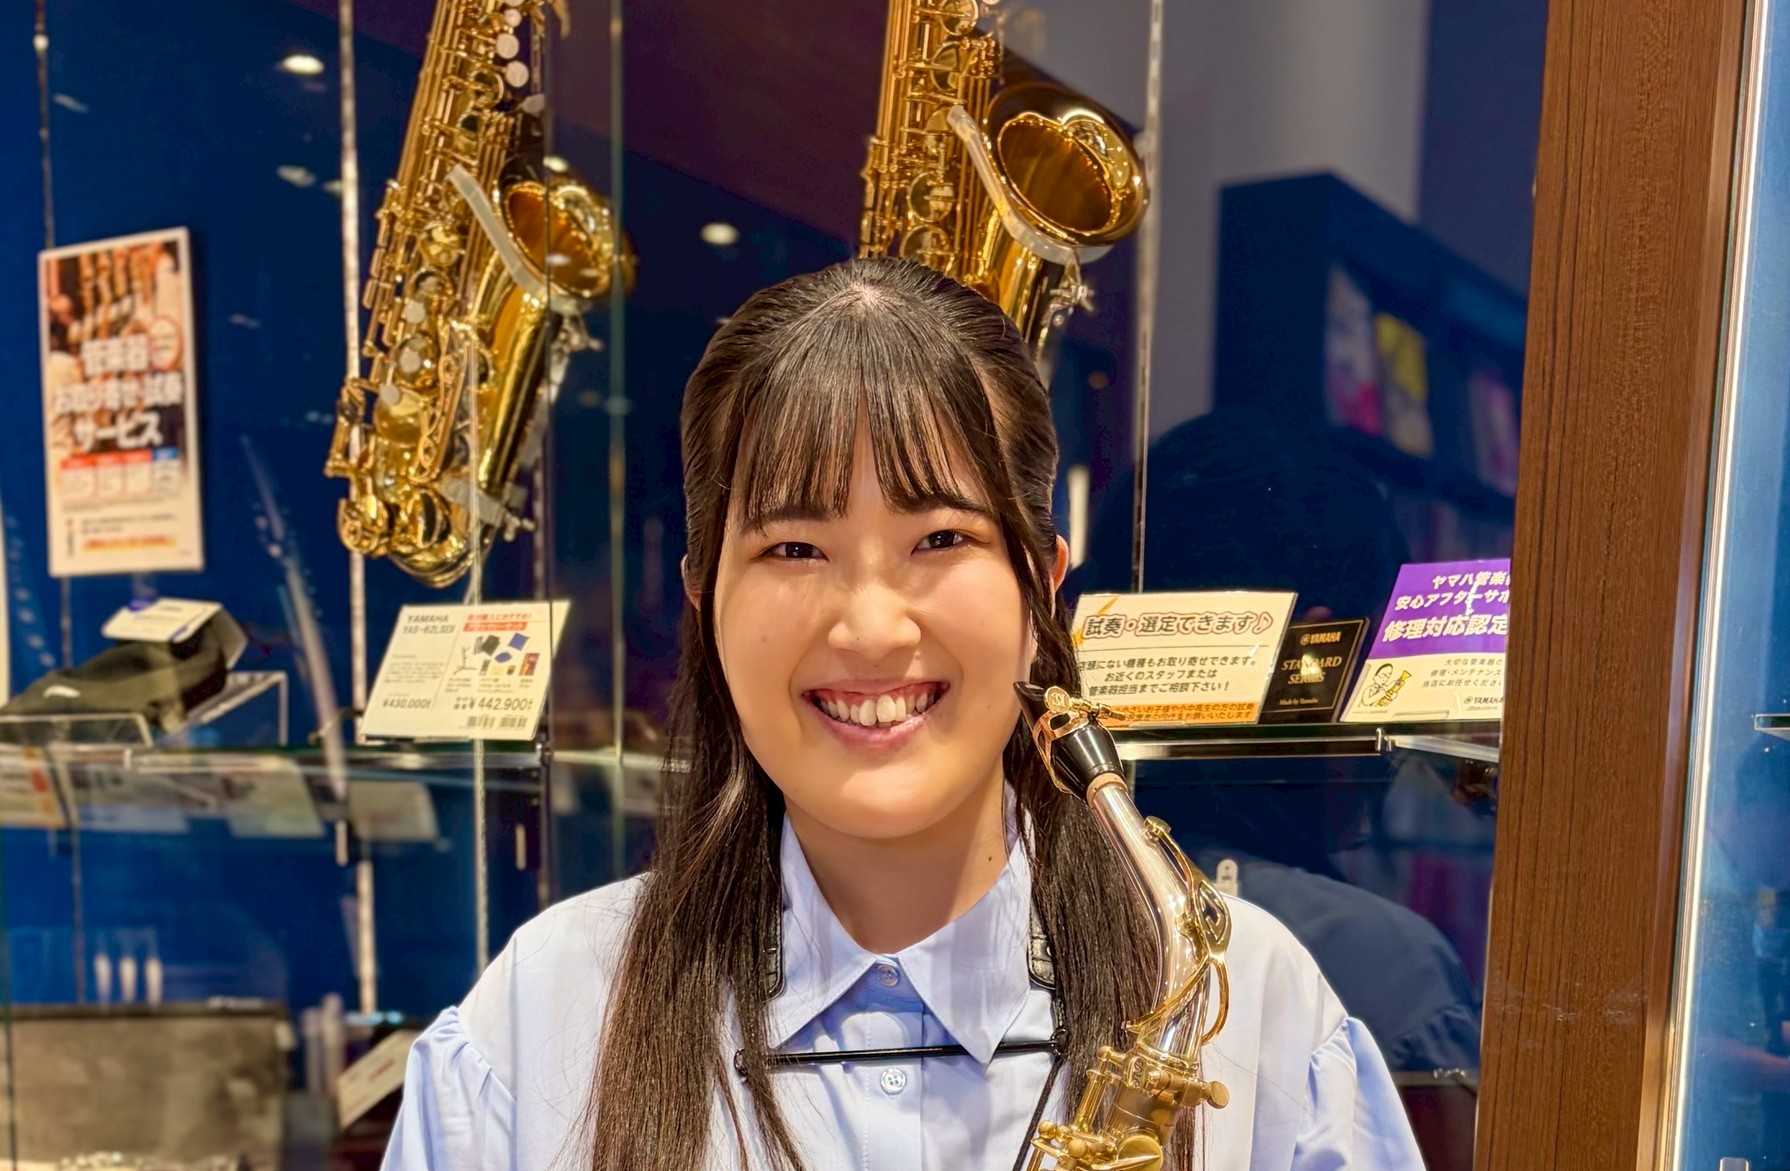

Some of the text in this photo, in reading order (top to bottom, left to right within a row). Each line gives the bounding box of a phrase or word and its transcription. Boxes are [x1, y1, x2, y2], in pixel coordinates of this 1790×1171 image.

[74, 411, 163, 453] サービス
[1432, 571, 1511, 590] ヤマハ管楽
[407, 614, 449, 623] YAMAHA
[1382, 613, 1507, 642] 修理対応認定
[1310, 632, 1341, 644] YAMAHA
[1281, 656, 1342, 671] STAARD
[1104, 669, 1218, 682] お近くのスタッフまたは
